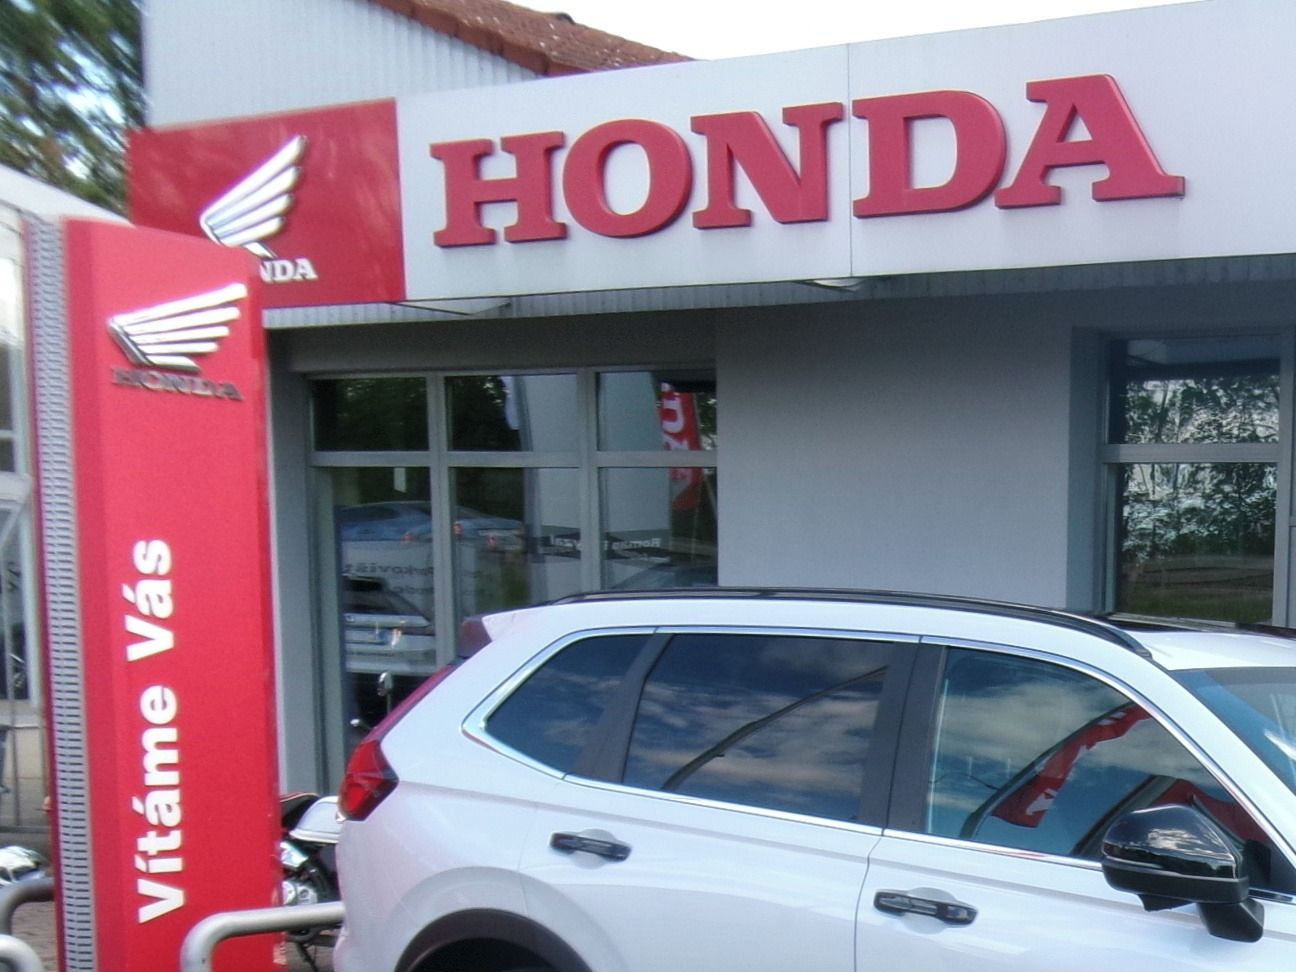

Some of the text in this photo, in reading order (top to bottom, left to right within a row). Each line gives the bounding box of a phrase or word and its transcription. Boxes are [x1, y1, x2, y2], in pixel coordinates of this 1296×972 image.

[430, 74, 1185, 248] HONDA
[259, 258, 318, 283] NDA
[111, 367, 243, 401] HONDA
[122, 538, 186, 924] Vítáme Vás
